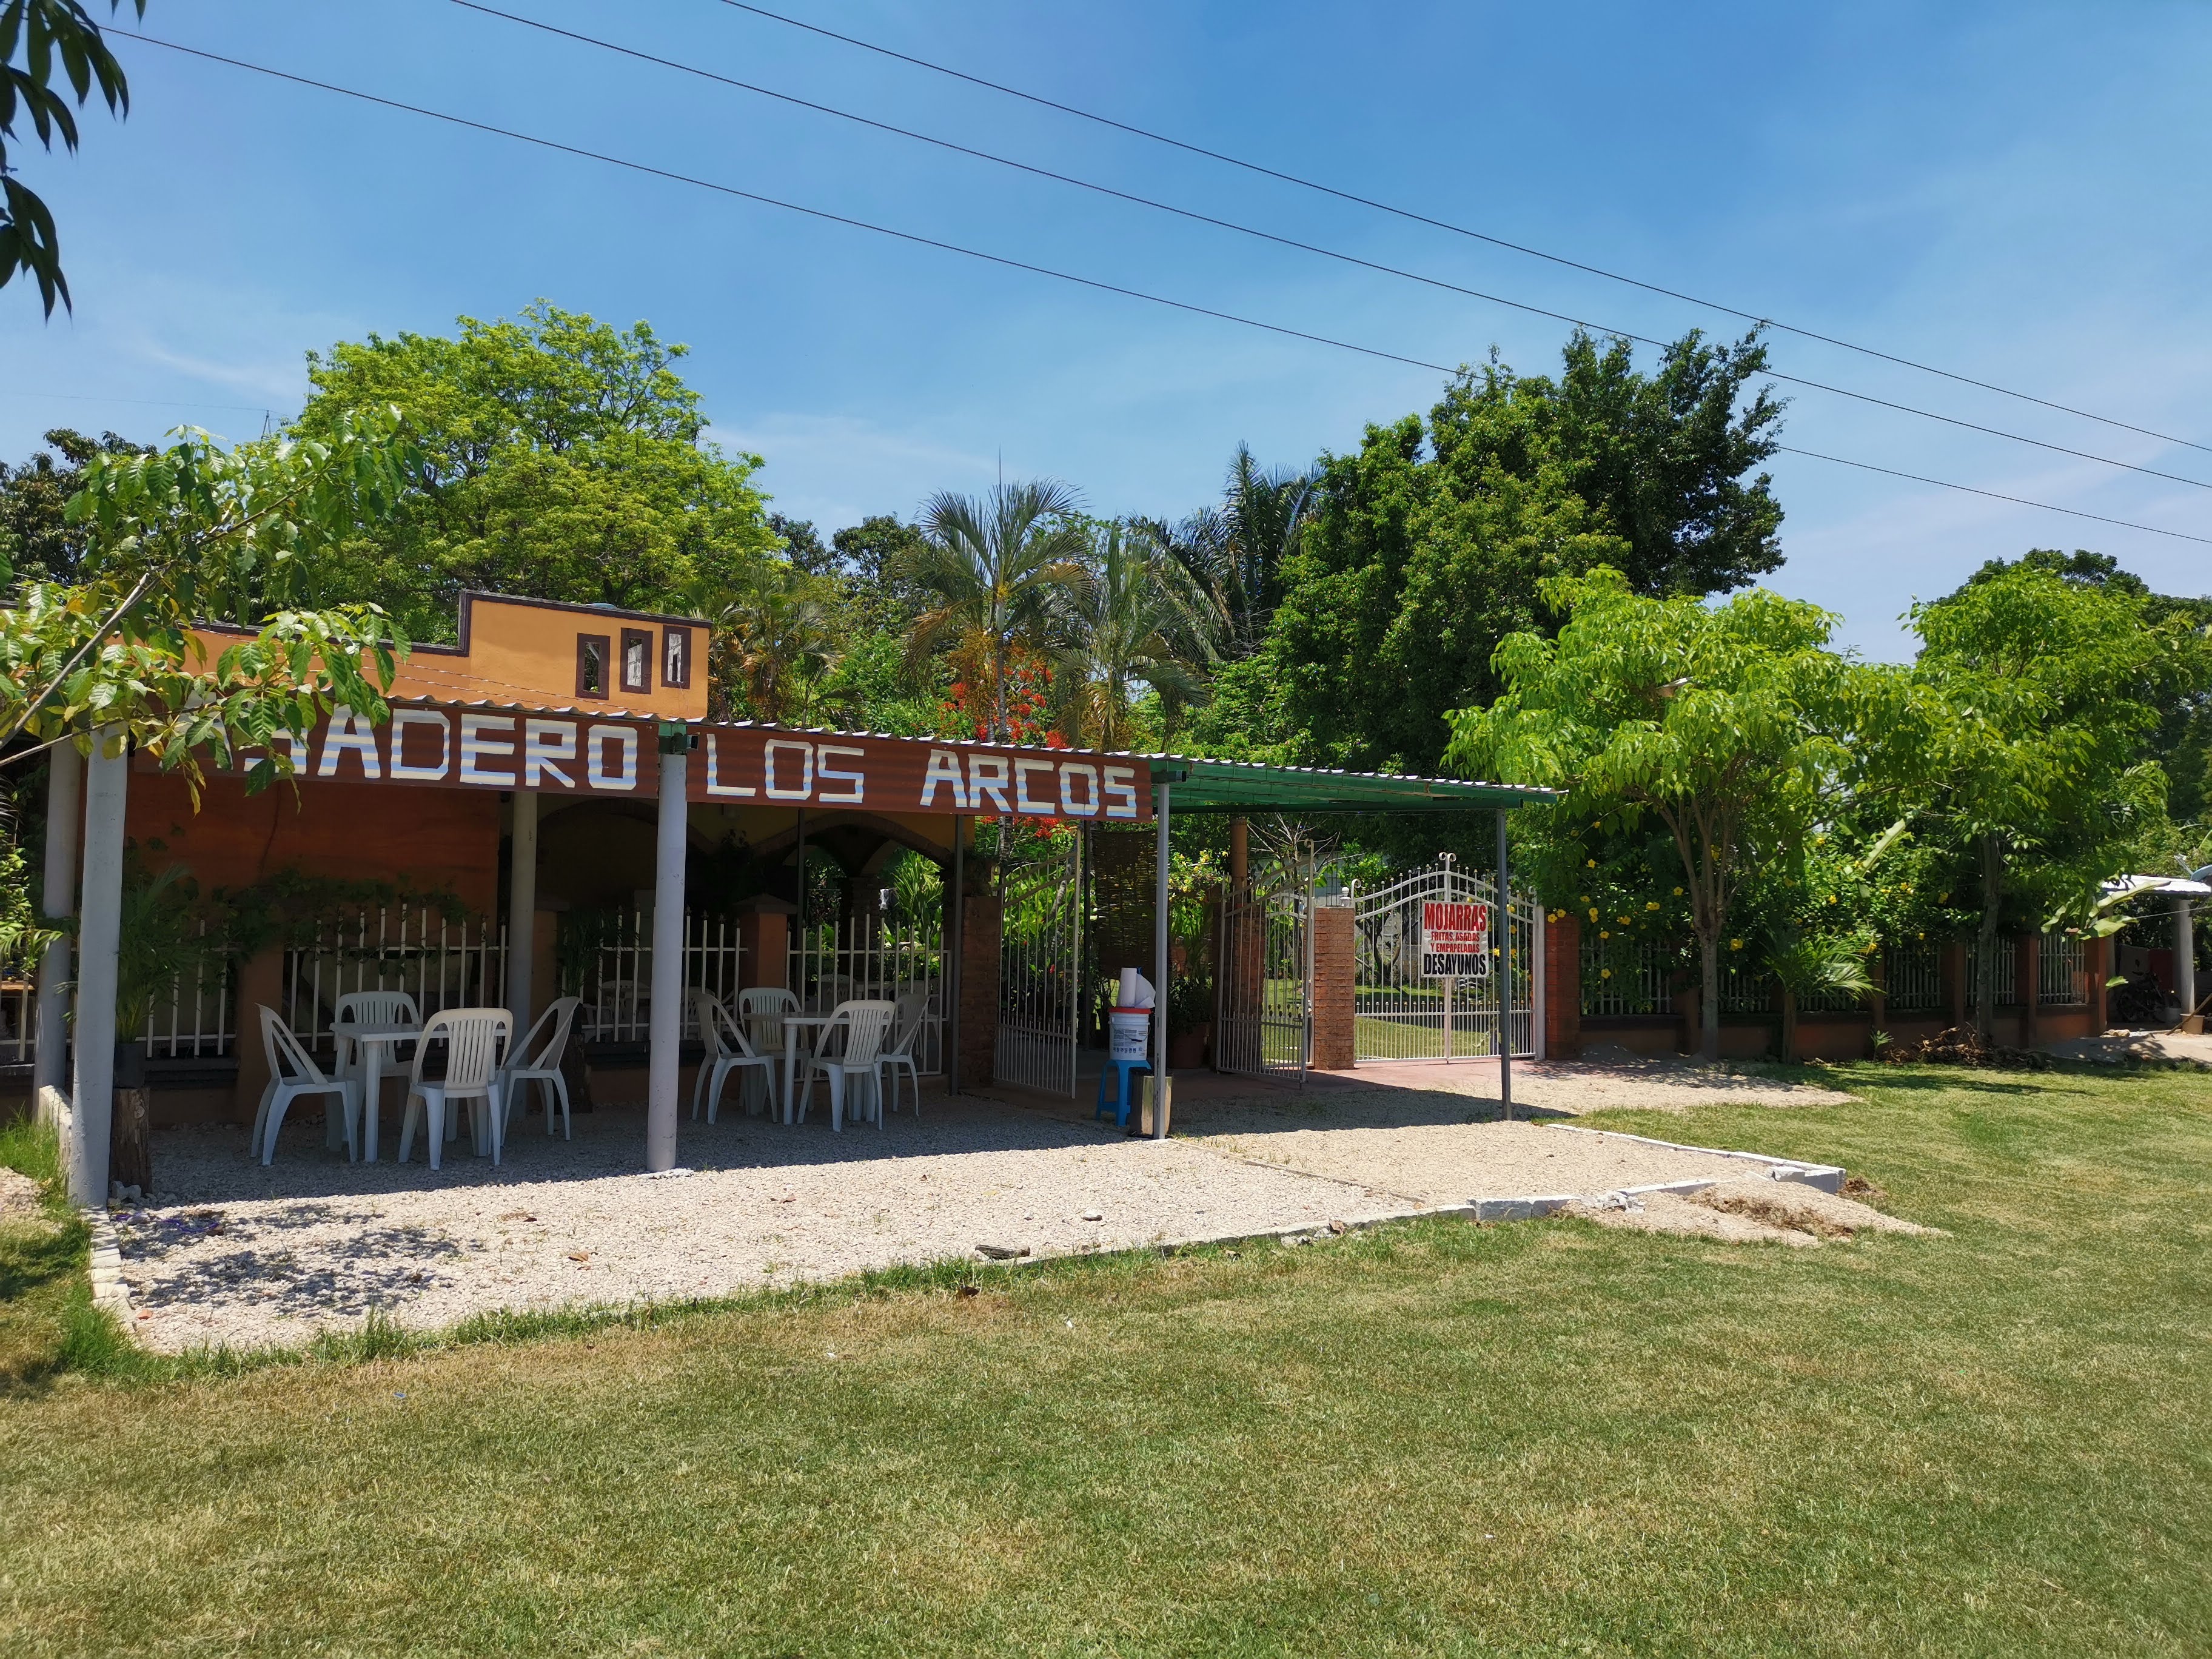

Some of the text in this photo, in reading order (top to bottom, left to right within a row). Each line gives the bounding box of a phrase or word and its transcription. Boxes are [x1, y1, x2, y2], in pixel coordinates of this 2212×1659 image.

[706, 734, 864, 803] LOS
[920, 749, 1137, 817] ARCOS
[1424, 903, 1486, 931] MOJARRAS
[1432, 931, 1480, 942] FRITAS, ASADAS
[1431, 943, 1480, 953] Y EMPAPELADAS
[1424, 953, 1486, 975] DESAYUNOS
